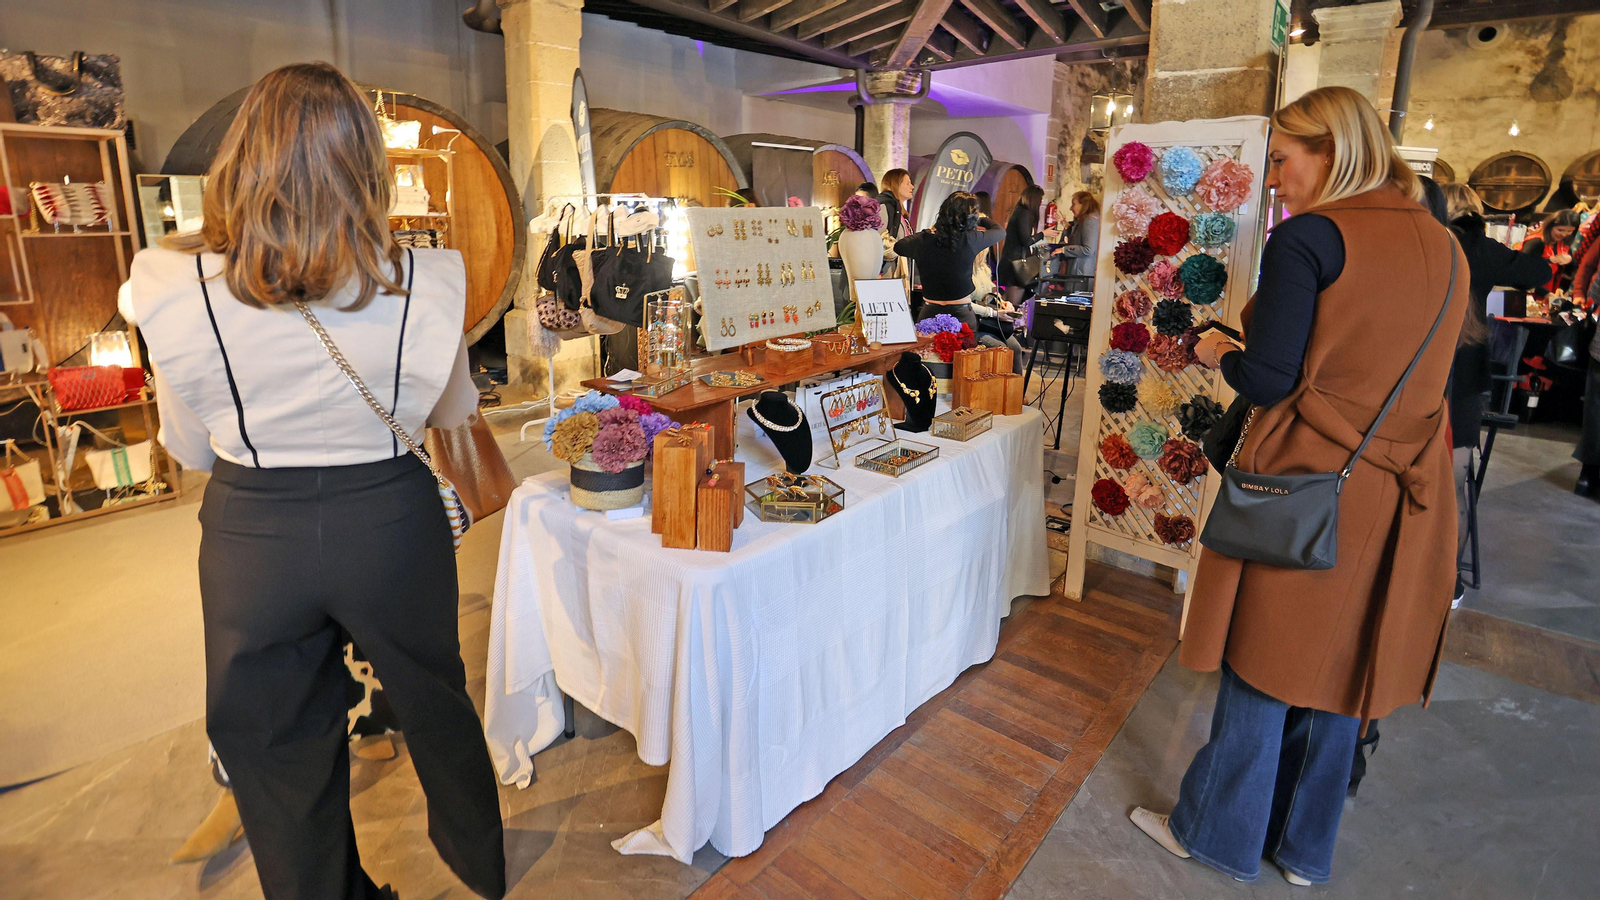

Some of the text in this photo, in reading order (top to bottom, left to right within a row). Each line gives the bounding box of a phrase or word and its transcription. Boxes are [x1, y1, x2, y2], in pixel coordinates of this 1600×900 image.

[936, 165, 974, 183] PETÓ
[1241, 483, 1264, 491] BIMBA
[1270, 487, 1289, 495] LOLA
